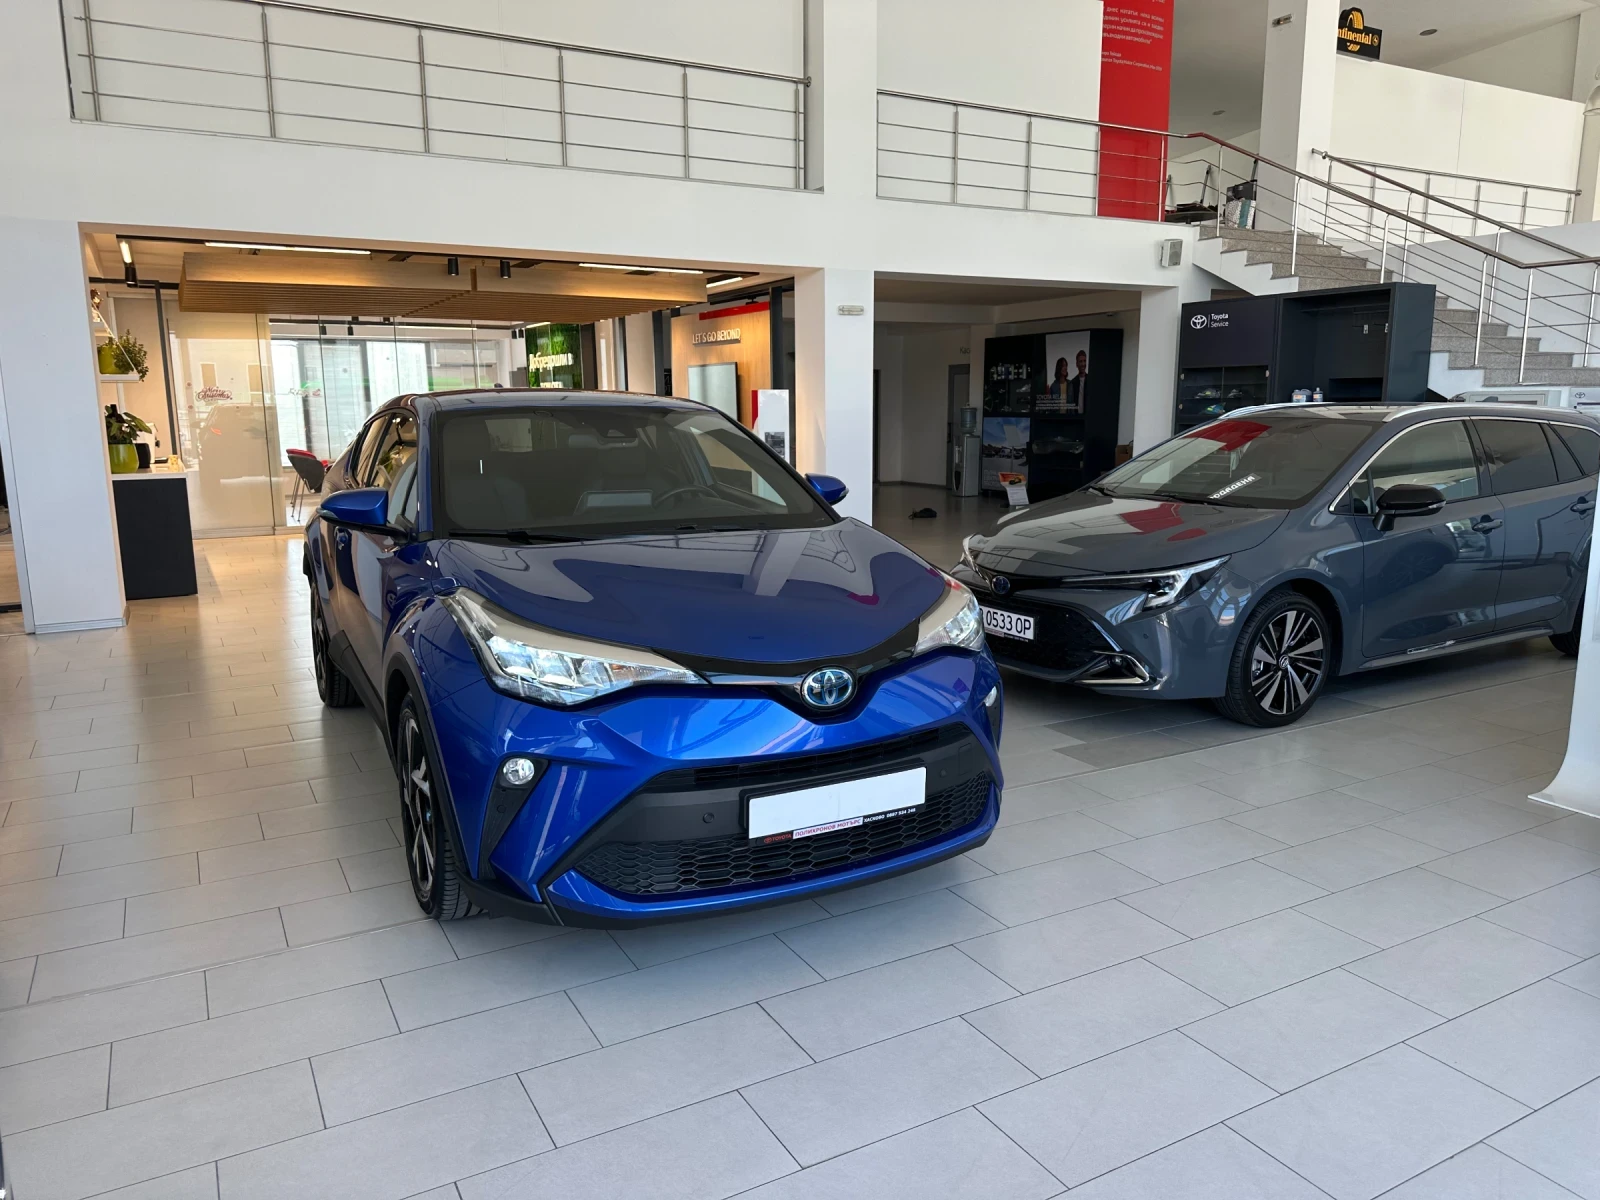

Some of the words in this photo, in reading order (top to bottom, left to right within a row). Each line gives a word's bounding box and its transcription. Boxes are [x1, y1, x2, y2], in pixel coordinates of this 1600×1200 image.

[1337, 28, 1371, 44] ntinental
[706, 330, 717, 343] GO
[717, 328, 741, 341] BEYOND
[1210, 475, 1256, 499] ОДАДЕНА
[986, 610, 1013, 631] 0533
[1015, 617, 1032, 635] OP
[772, 833, 792, 842] TOYOTA
[794, 824, 836, 838] ПОЛИХРОНОВ
[837, 819, 861, 829] МОТЪРС
[863, 814, 885, 823] ХАСКОВО
